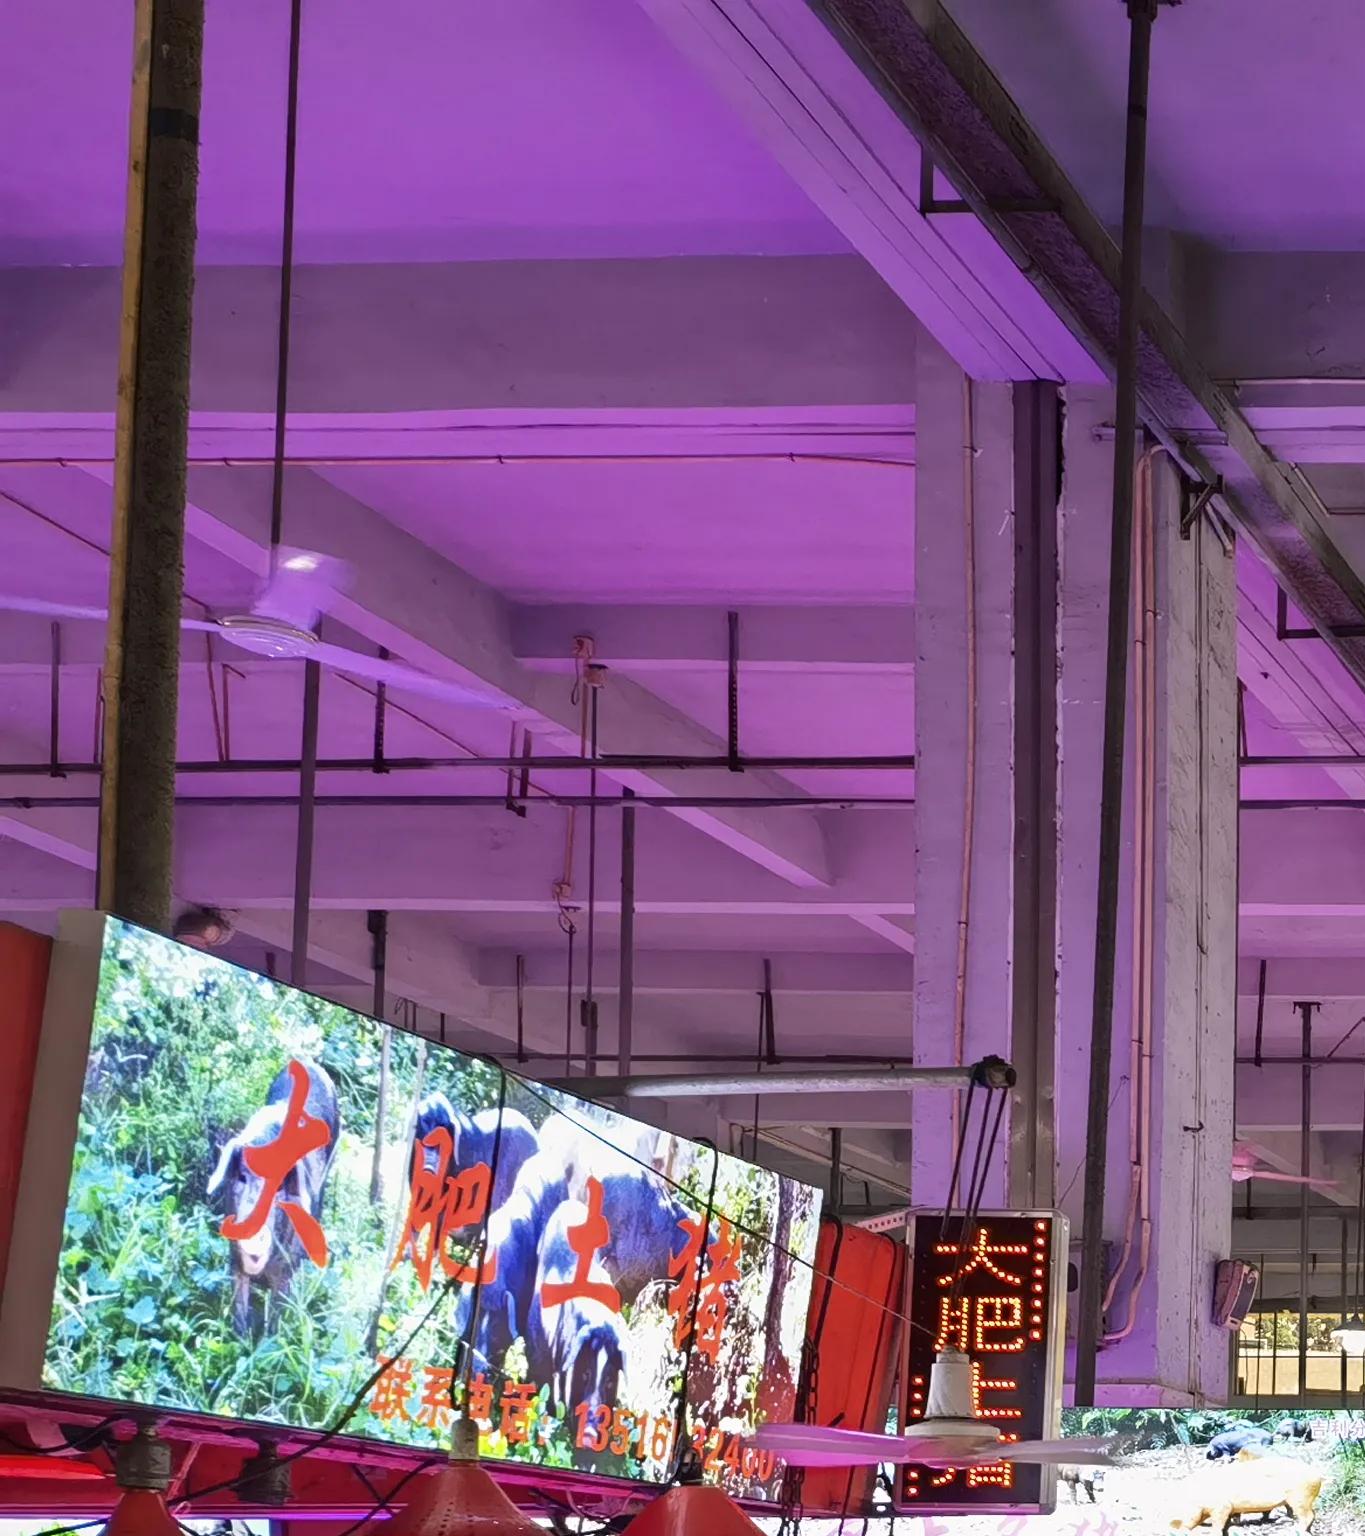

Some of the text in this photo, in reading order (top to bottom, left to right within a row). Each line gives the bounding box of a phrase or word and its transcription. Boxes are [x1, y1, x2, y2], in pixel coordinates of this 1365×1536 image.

[220, 1059, 742, 1366] 大肥土猪
[936, 1228, 1028, 1487] 大肥土
